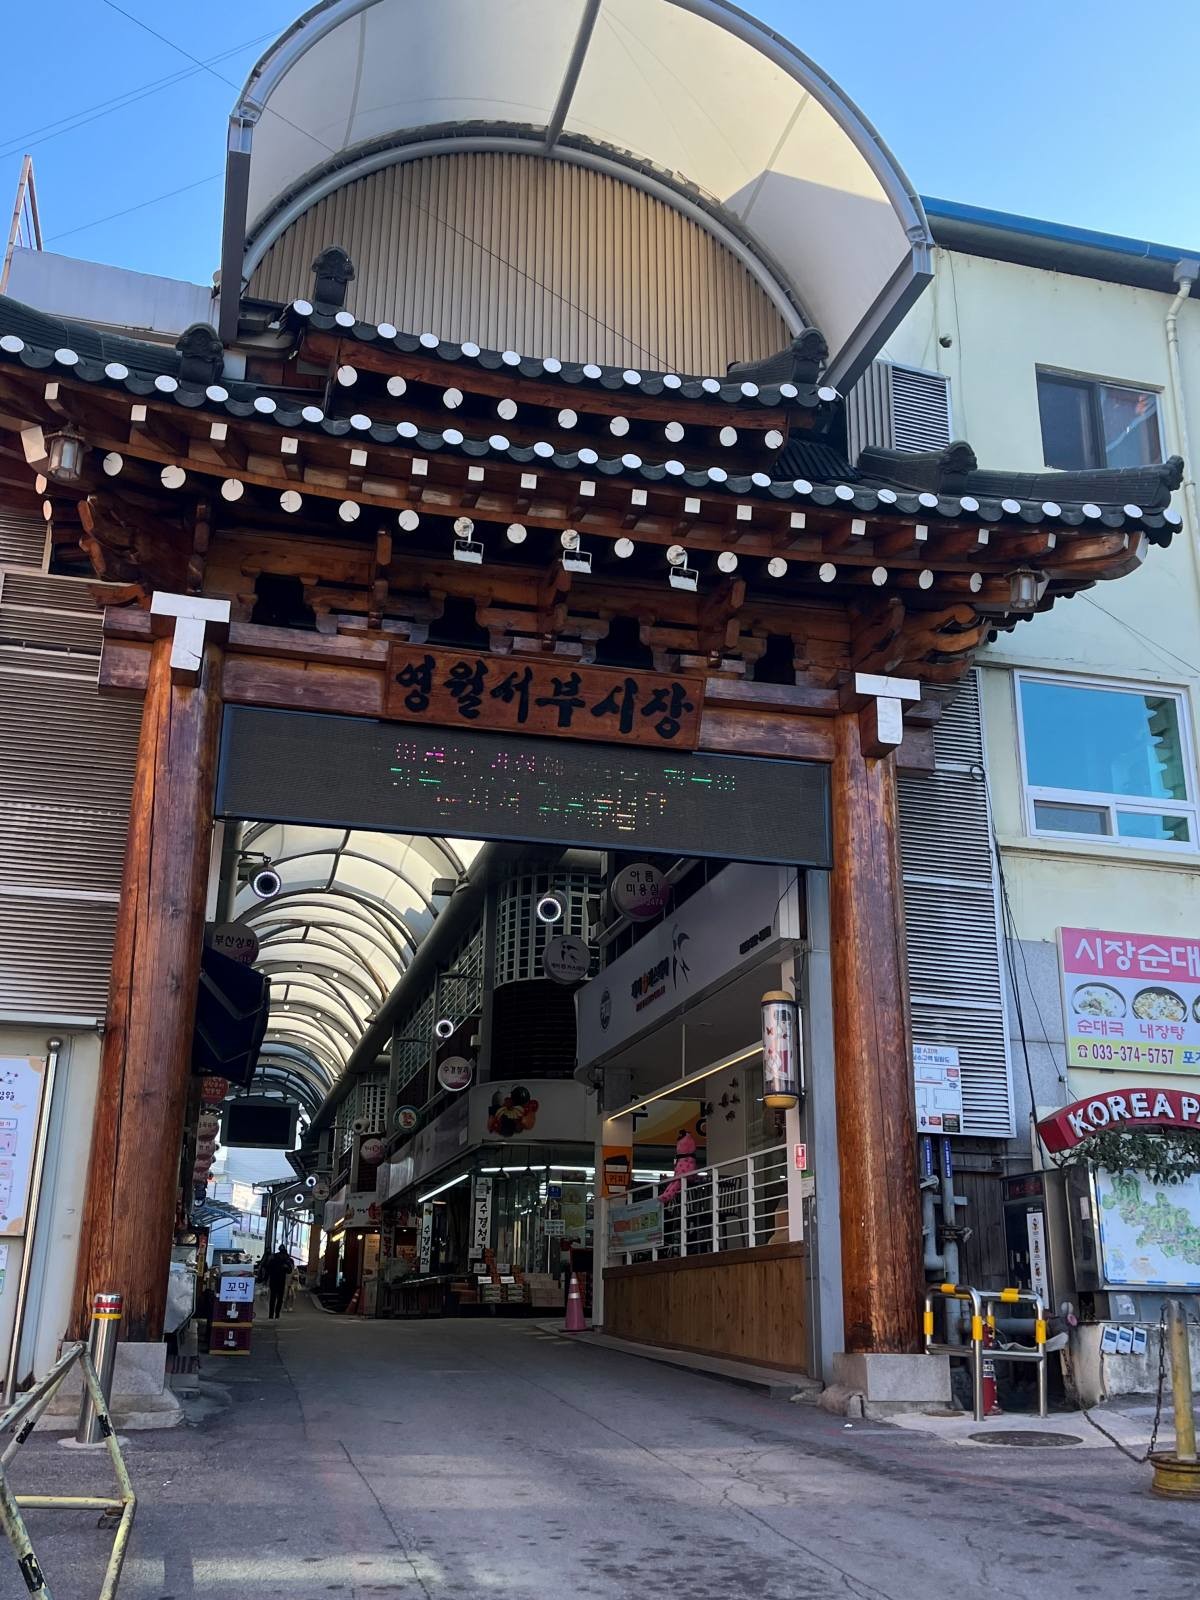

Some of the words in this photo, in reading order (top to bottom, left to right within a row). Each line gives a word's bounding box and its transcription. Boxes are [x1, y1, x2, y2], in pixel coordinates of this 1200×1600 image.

[395, 654, 694, 739] 영월서부시장
[626, 883, 659, 896] 미용실
[1077, 1020, 1124, 1037] 순대국
[1139, 1023, 1185, 1041] 내장탕
[1092, 1043, 1174, 1065] 033-374-5757
[1067, 1092, 1175, 1138] KOREA
[226, 1282, 248, 1294] 꼬막
